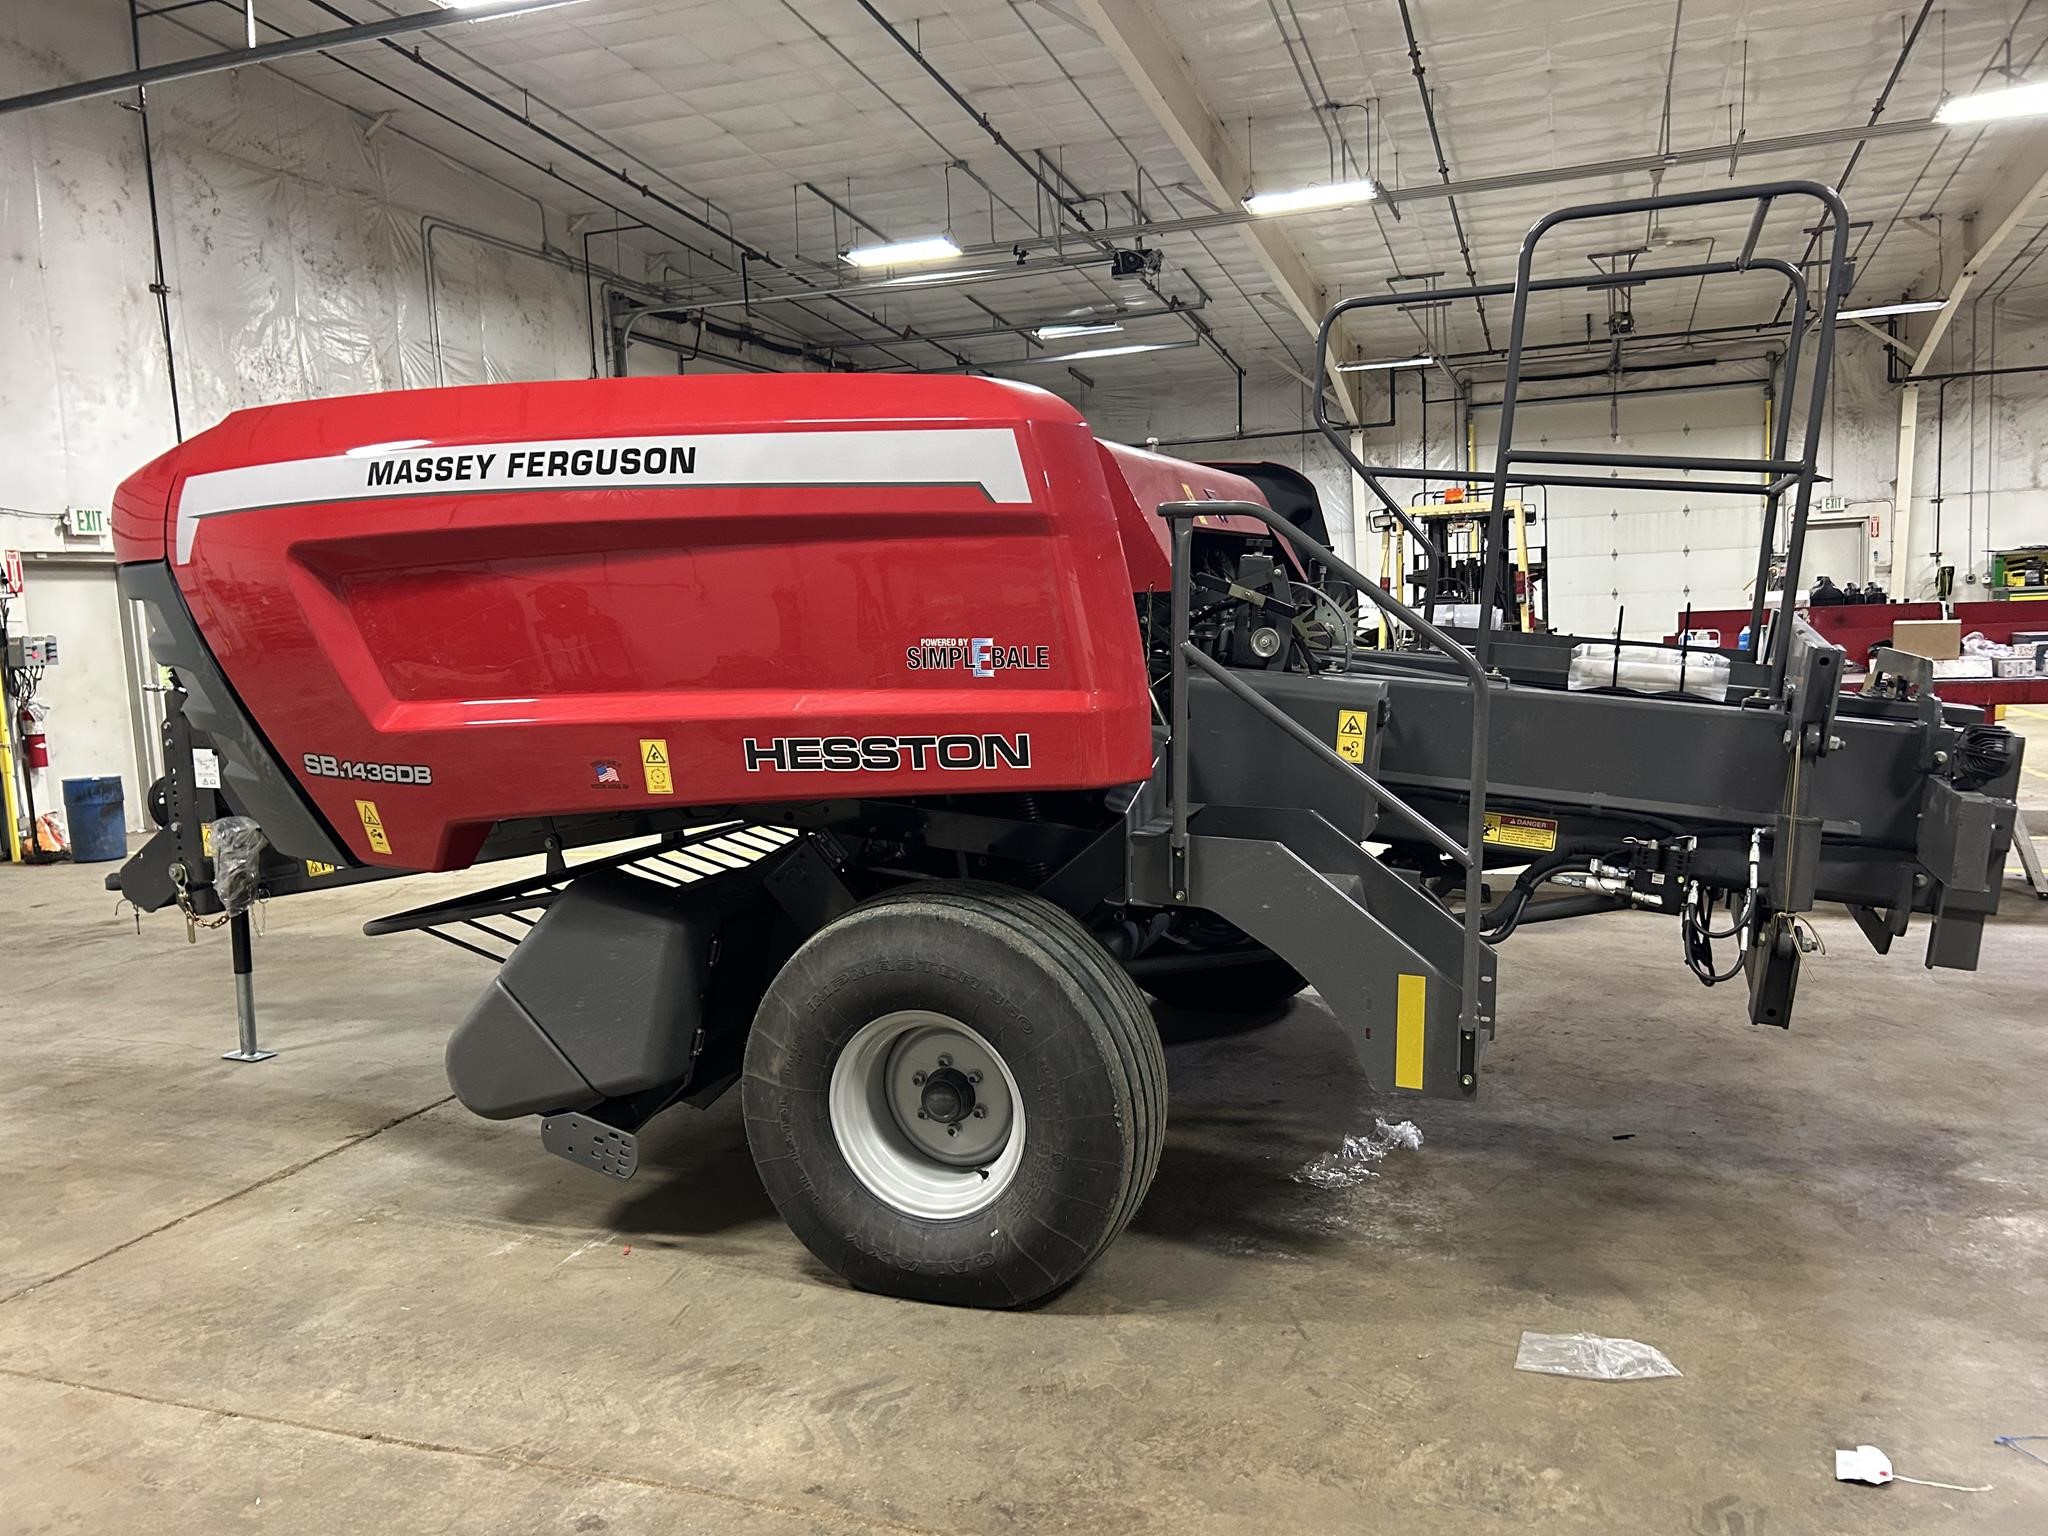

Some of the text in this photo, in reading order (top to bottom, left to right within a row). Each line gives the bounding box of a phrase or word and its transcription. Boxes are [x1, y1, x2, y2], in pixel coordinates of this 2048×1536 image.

[367, 447, 696, 486] MASSEY FERGUSON
[1825, 497, 1842, 509] EXIT
[77, 510, 102, 531] EXIT
[920, 638, 968, 647] POWERED BY
[743, 733, 1032, 771] HESSTON
[303, 753, 432, 785] SB.1436DB
[1516, 819, 1547, 828] DANGER
